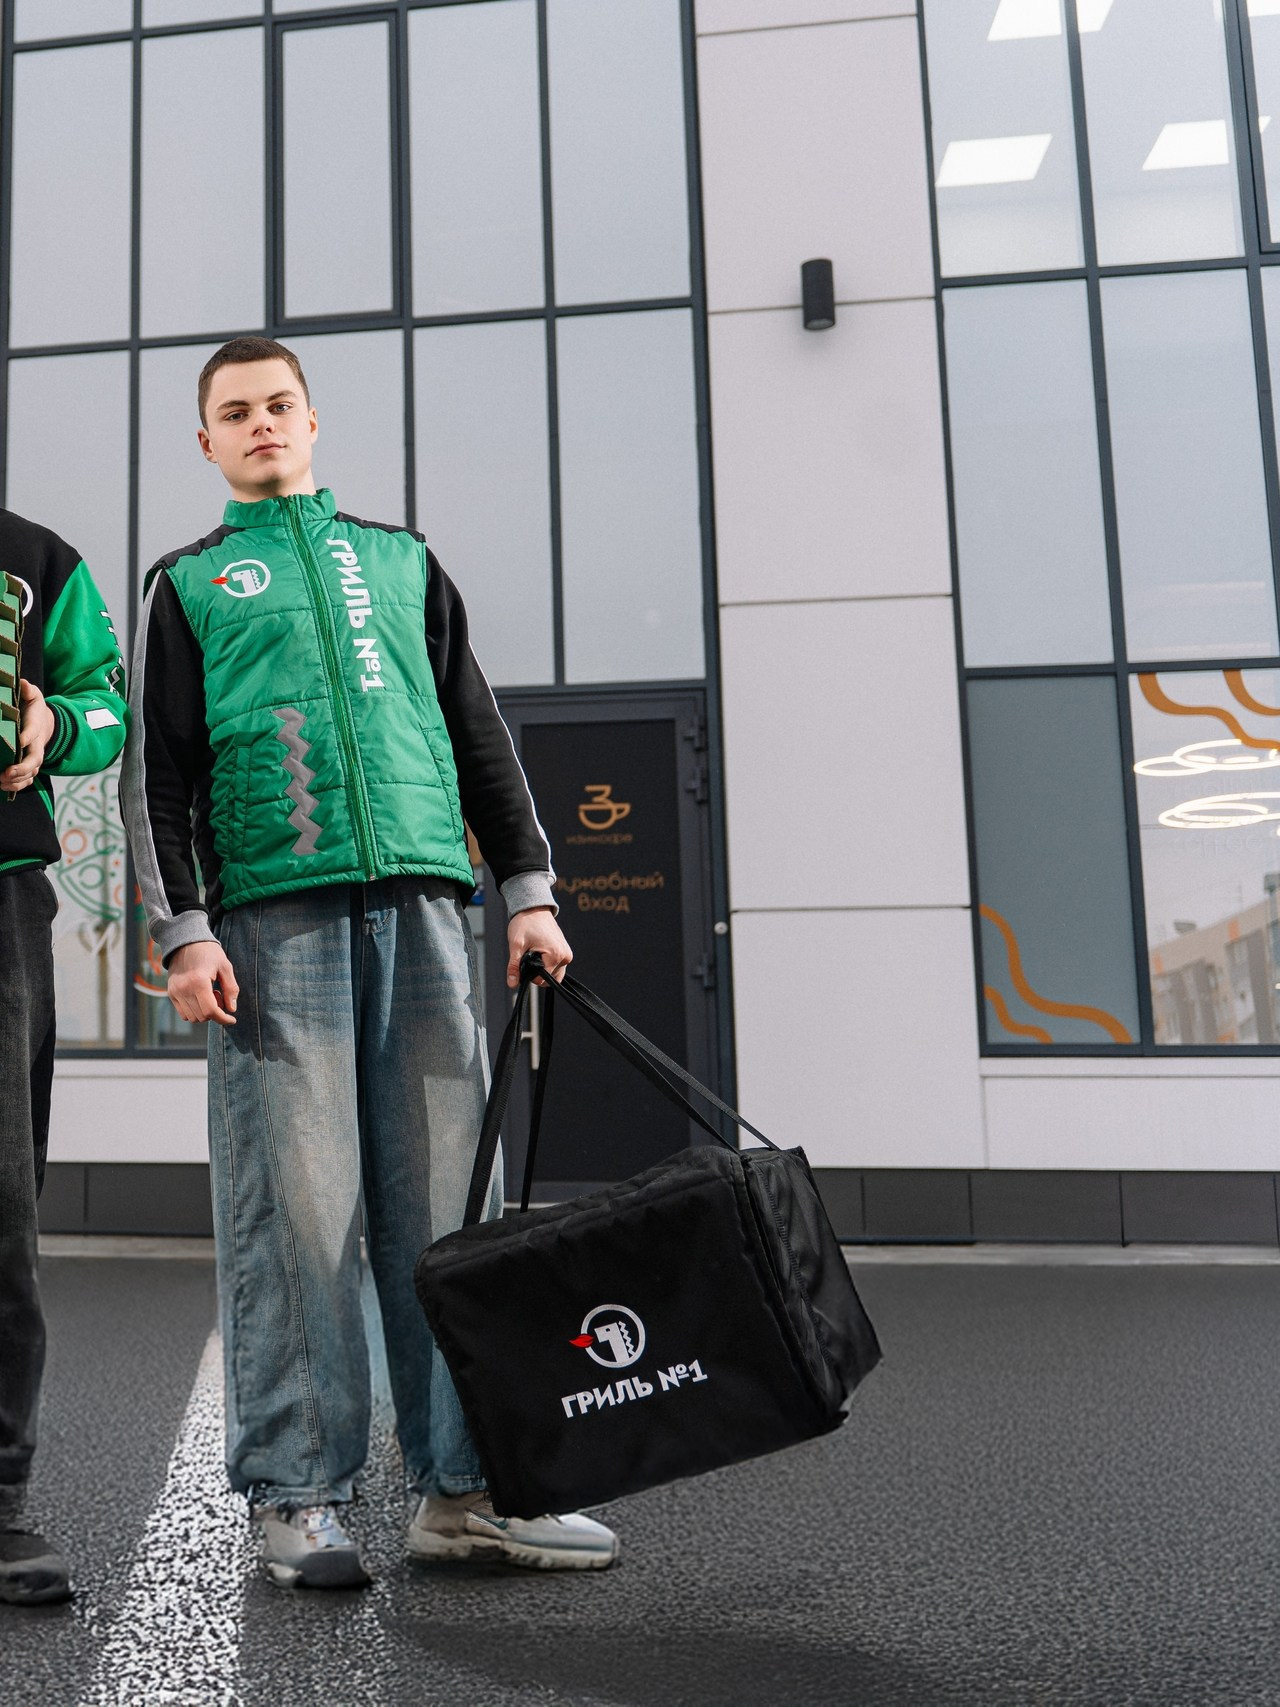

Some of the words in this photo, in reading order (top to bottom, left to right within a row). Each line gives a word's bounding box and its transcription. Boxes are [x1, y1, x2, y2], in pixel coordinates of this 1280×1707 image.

[326, 538, 373, 629] ГРИЛЬ
[353, 638, 386, 693] №1
[556, 870, 665, 895] лужебный
[560, 1375, 654, 1419] ГРИЛЬ
[656, 1359, 709, 1392] №1
